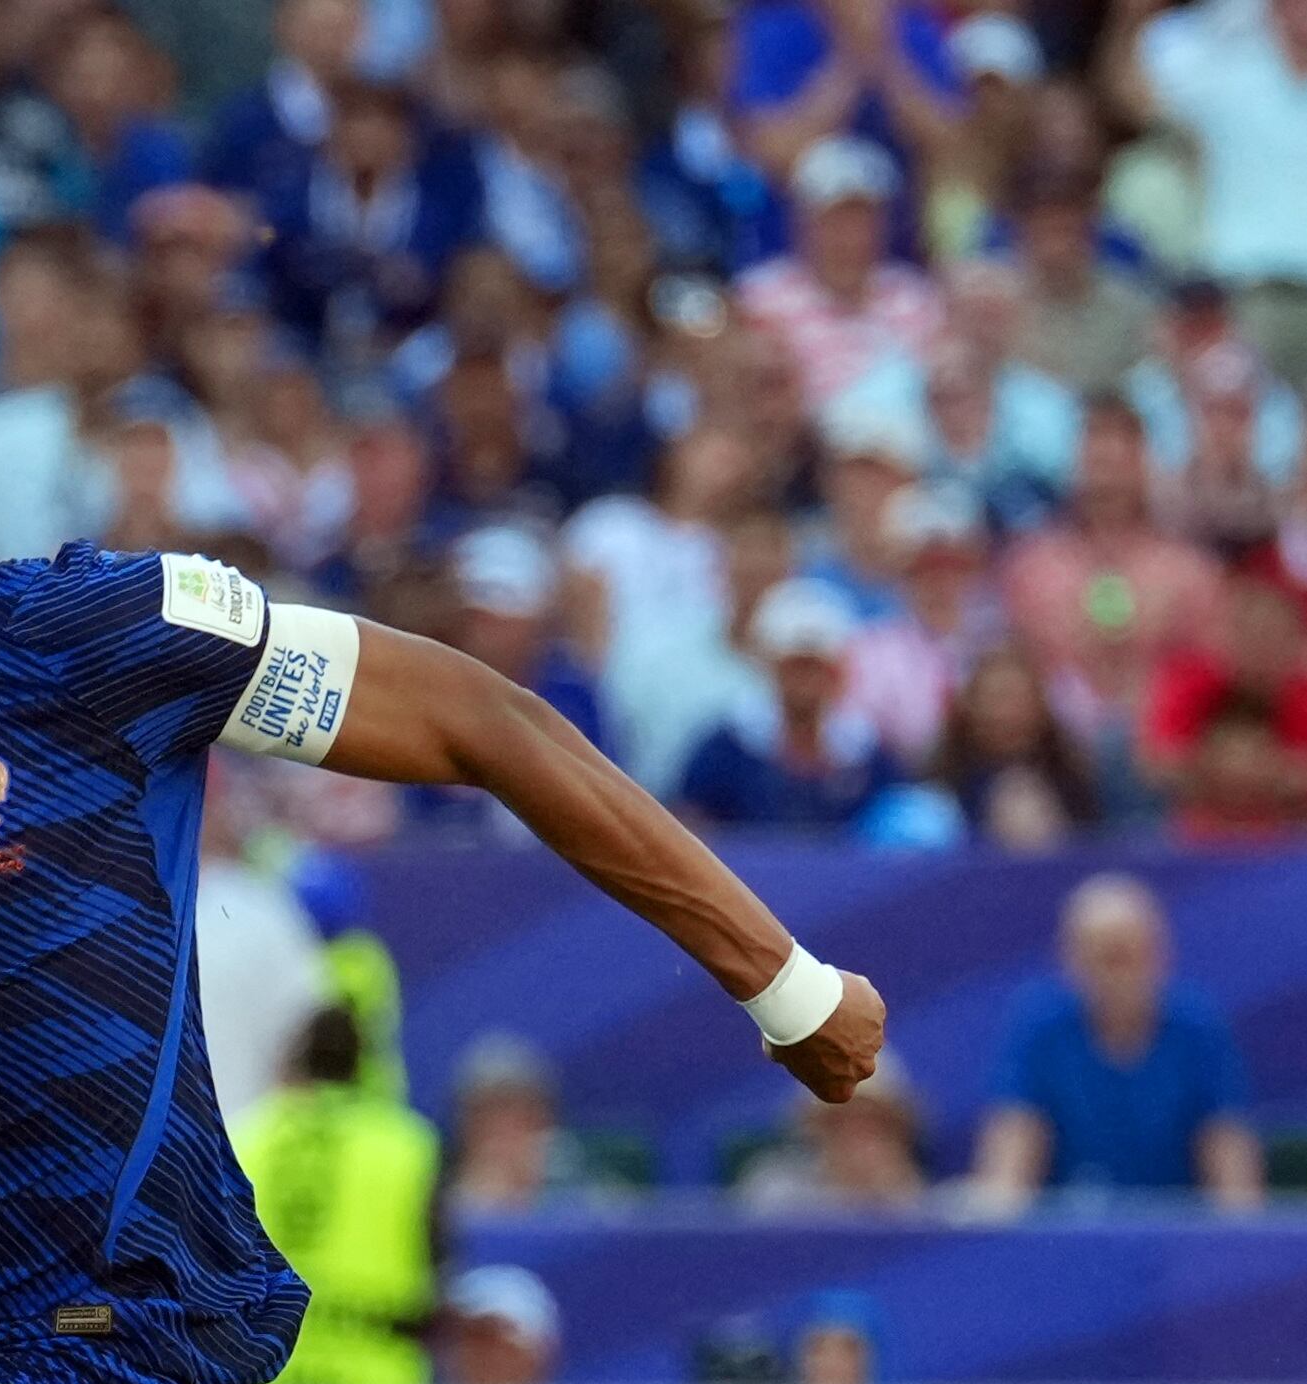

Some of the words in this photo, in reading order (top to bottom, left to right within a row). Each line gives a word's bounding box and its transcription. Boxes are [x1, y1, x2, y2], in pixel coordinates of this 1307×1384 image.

[240, 646, 286, 728] FOOTBALL
[258, 650, 307, 738] UNITES
[285, 718, 310, 747] the
[298, 650, 330, 715] World
[316, 689, 342, 733] FIFA
